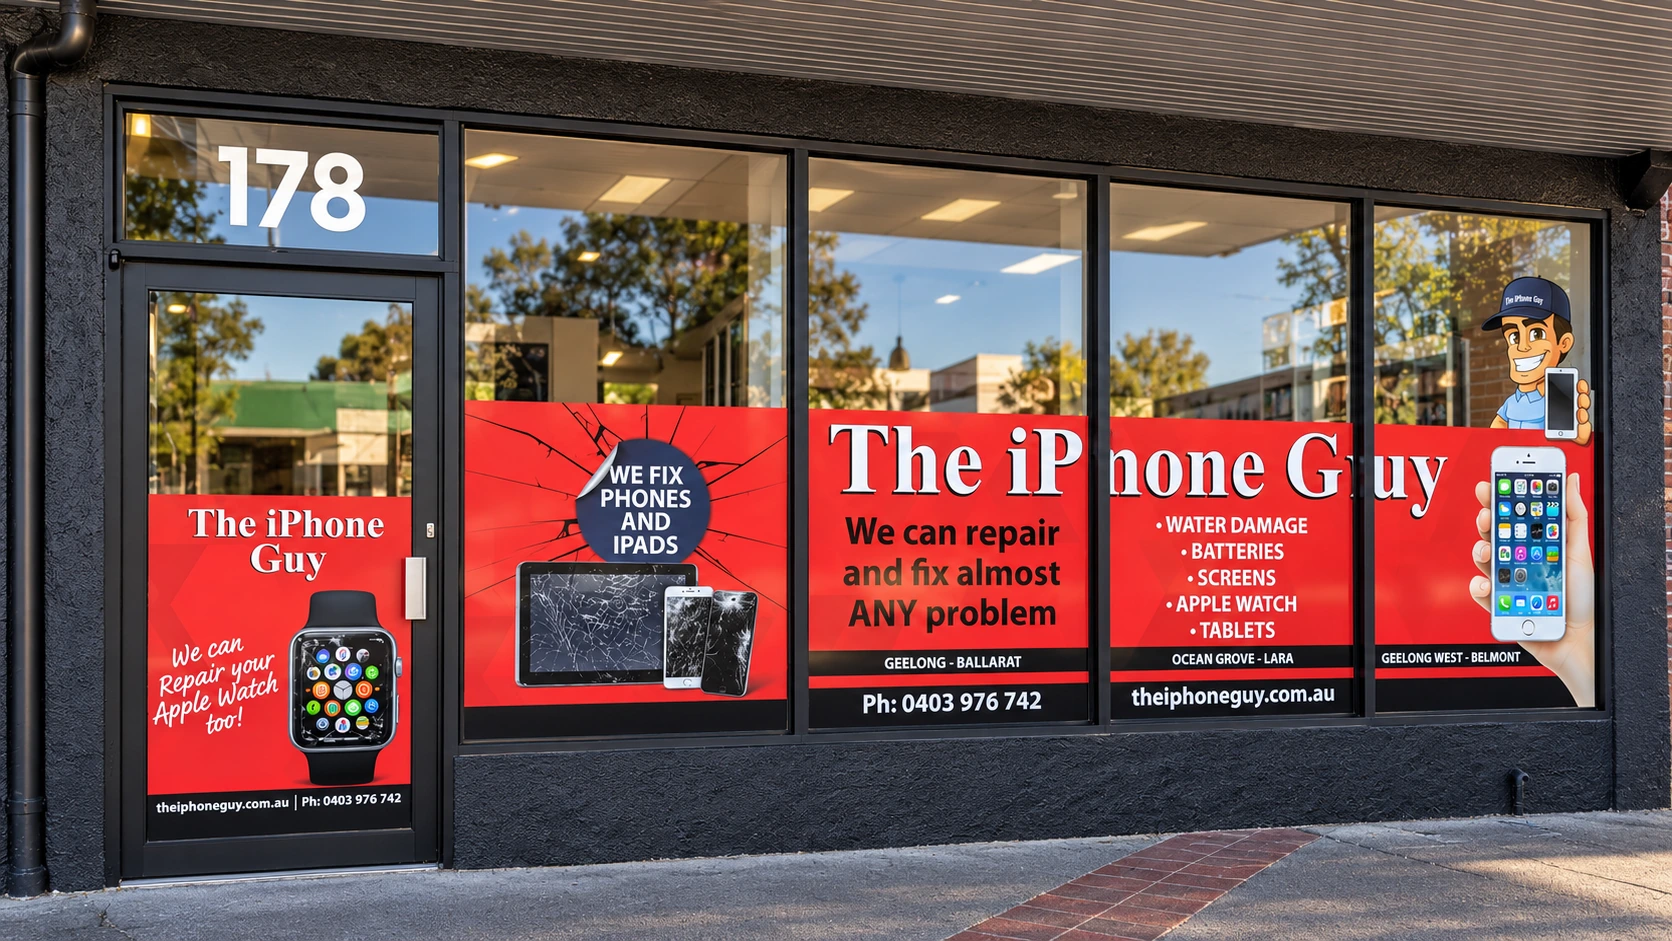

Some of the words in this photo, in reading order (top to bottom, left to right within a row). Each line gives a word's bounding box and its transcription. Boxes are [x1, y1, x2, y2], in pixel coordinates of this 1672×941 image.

[217, 145, 367, 233] 178
[609, 466, 644, 485] WE
[649, 466, 684, 485] FIX
[829, 423, 983, 496] The
[1286, 429, 1449, 519] Guy
[600, 489, 692, 509] PHONES
[187, 508, 257, 538] The
[265, 508, 385, 538] iPhone
[620, 511, 671, 531] AND
[1165, 515, 1227, 534] WATER
[1230, 516, 1308, 534] DAMAGE
[613, 535, 679, 555] IPADS
[845, 516, 895, 545] We
[903, 524, 957, 546] can
[966, 518, 1060, 553] repair
[250, 543, 327, 582] Guy
[1191, 542, 1285, 560] BATTERIES
[843, 557, 902, 586] and
[911, 557, 949, 586] fix
[957, 558, 1061, 586] almost
[1197, 568, 1276, 587] SCREENS
[848, 599, 918, 627] ANY
[926, 597, 1056, 634] problem
[1175, 595, 1232, 613] APPLE
[1235, 595, 1298, 613] WATCH
[1199, 621, 1276, 639] TABLETS
[172, 643, 203, 668] We
[207, 637, 245, 658] can
[884, 656, 946, 670] GEELONG
[956, 655, 1022, 669] BALLARAT
[1171, 653, 1213, 665] OCEAN
[1215, 652, 1255, 665] GROVE
[1264, 652, 1294, 664] LARA
[1381, 652, 1432, 664] GEELONG
[1434, 651, 1463, 663] WEST
[1471, 651, 1521, 663] BELMONT
[159, 663, 226, 698] Repair
[231, 653, 276, 685] your
[152, 689, 212, 728] Apple
[218, 671, 279, 707] Watch
[863, 693, 897, 714] Ph:
[901, 693, 955, 713] 0403
[960, 691, 999, 712] 976
[1004, 691, 1042, 711] 742
[1131, 685, 1335, 711] theiphoneguy.com.au
[205, 706, 244, 735] too!
[155, 799, 289, 815] theiphoneguy.com.au
[301, 795, 321, 807] Ph:
[323, 794, 353, 806] 0403
[355, 793, 378, 805] 976
[380, 792, 402, 804] 742
